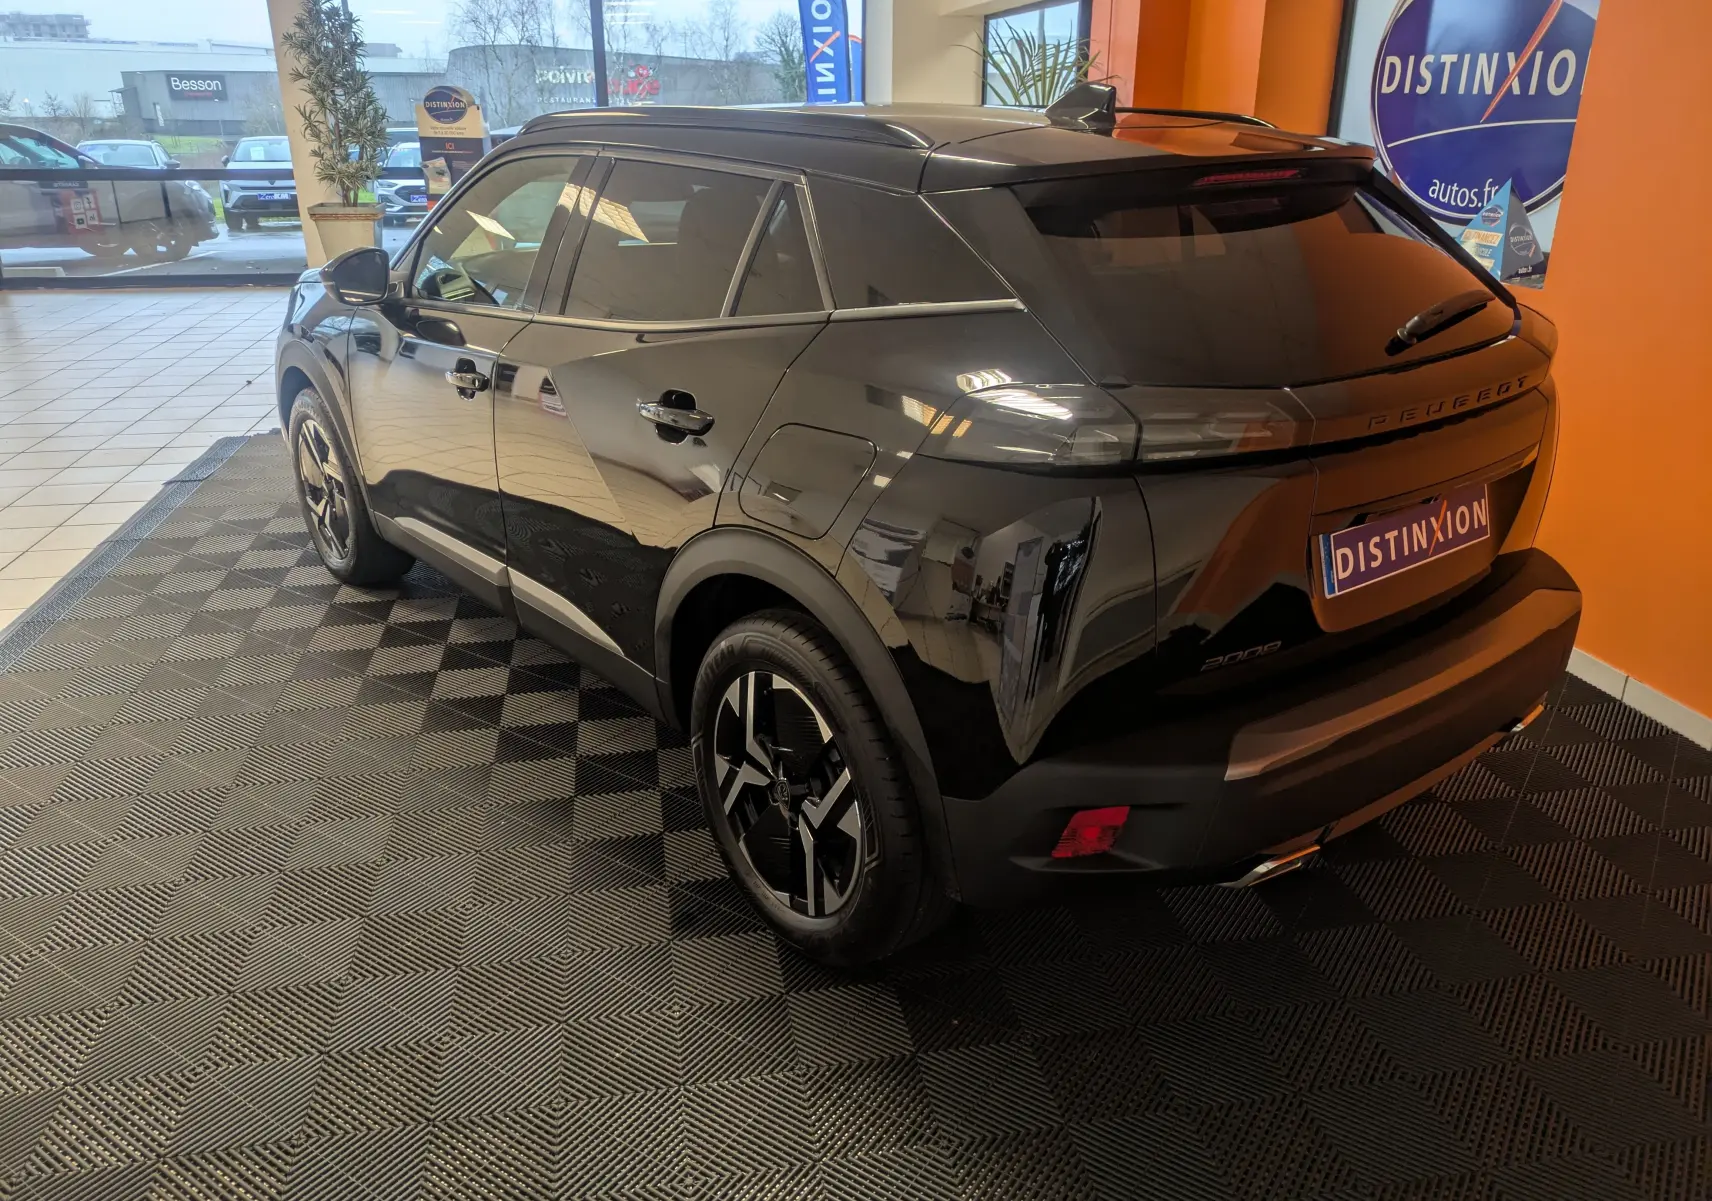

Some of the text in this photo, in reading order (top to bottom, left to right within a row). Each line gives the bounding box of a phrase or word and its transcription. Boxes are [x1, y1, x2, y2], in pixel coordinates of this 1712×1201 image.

[170, 77, 222, 90] Besson
[1381, 49, 1592, 96] DISTINXIO
[1367, 375, 1528, 430] PEUGEOT
[1335, 499, 1487, 580] DISTINXION
[1200, 641, 1282, 671] 2008
